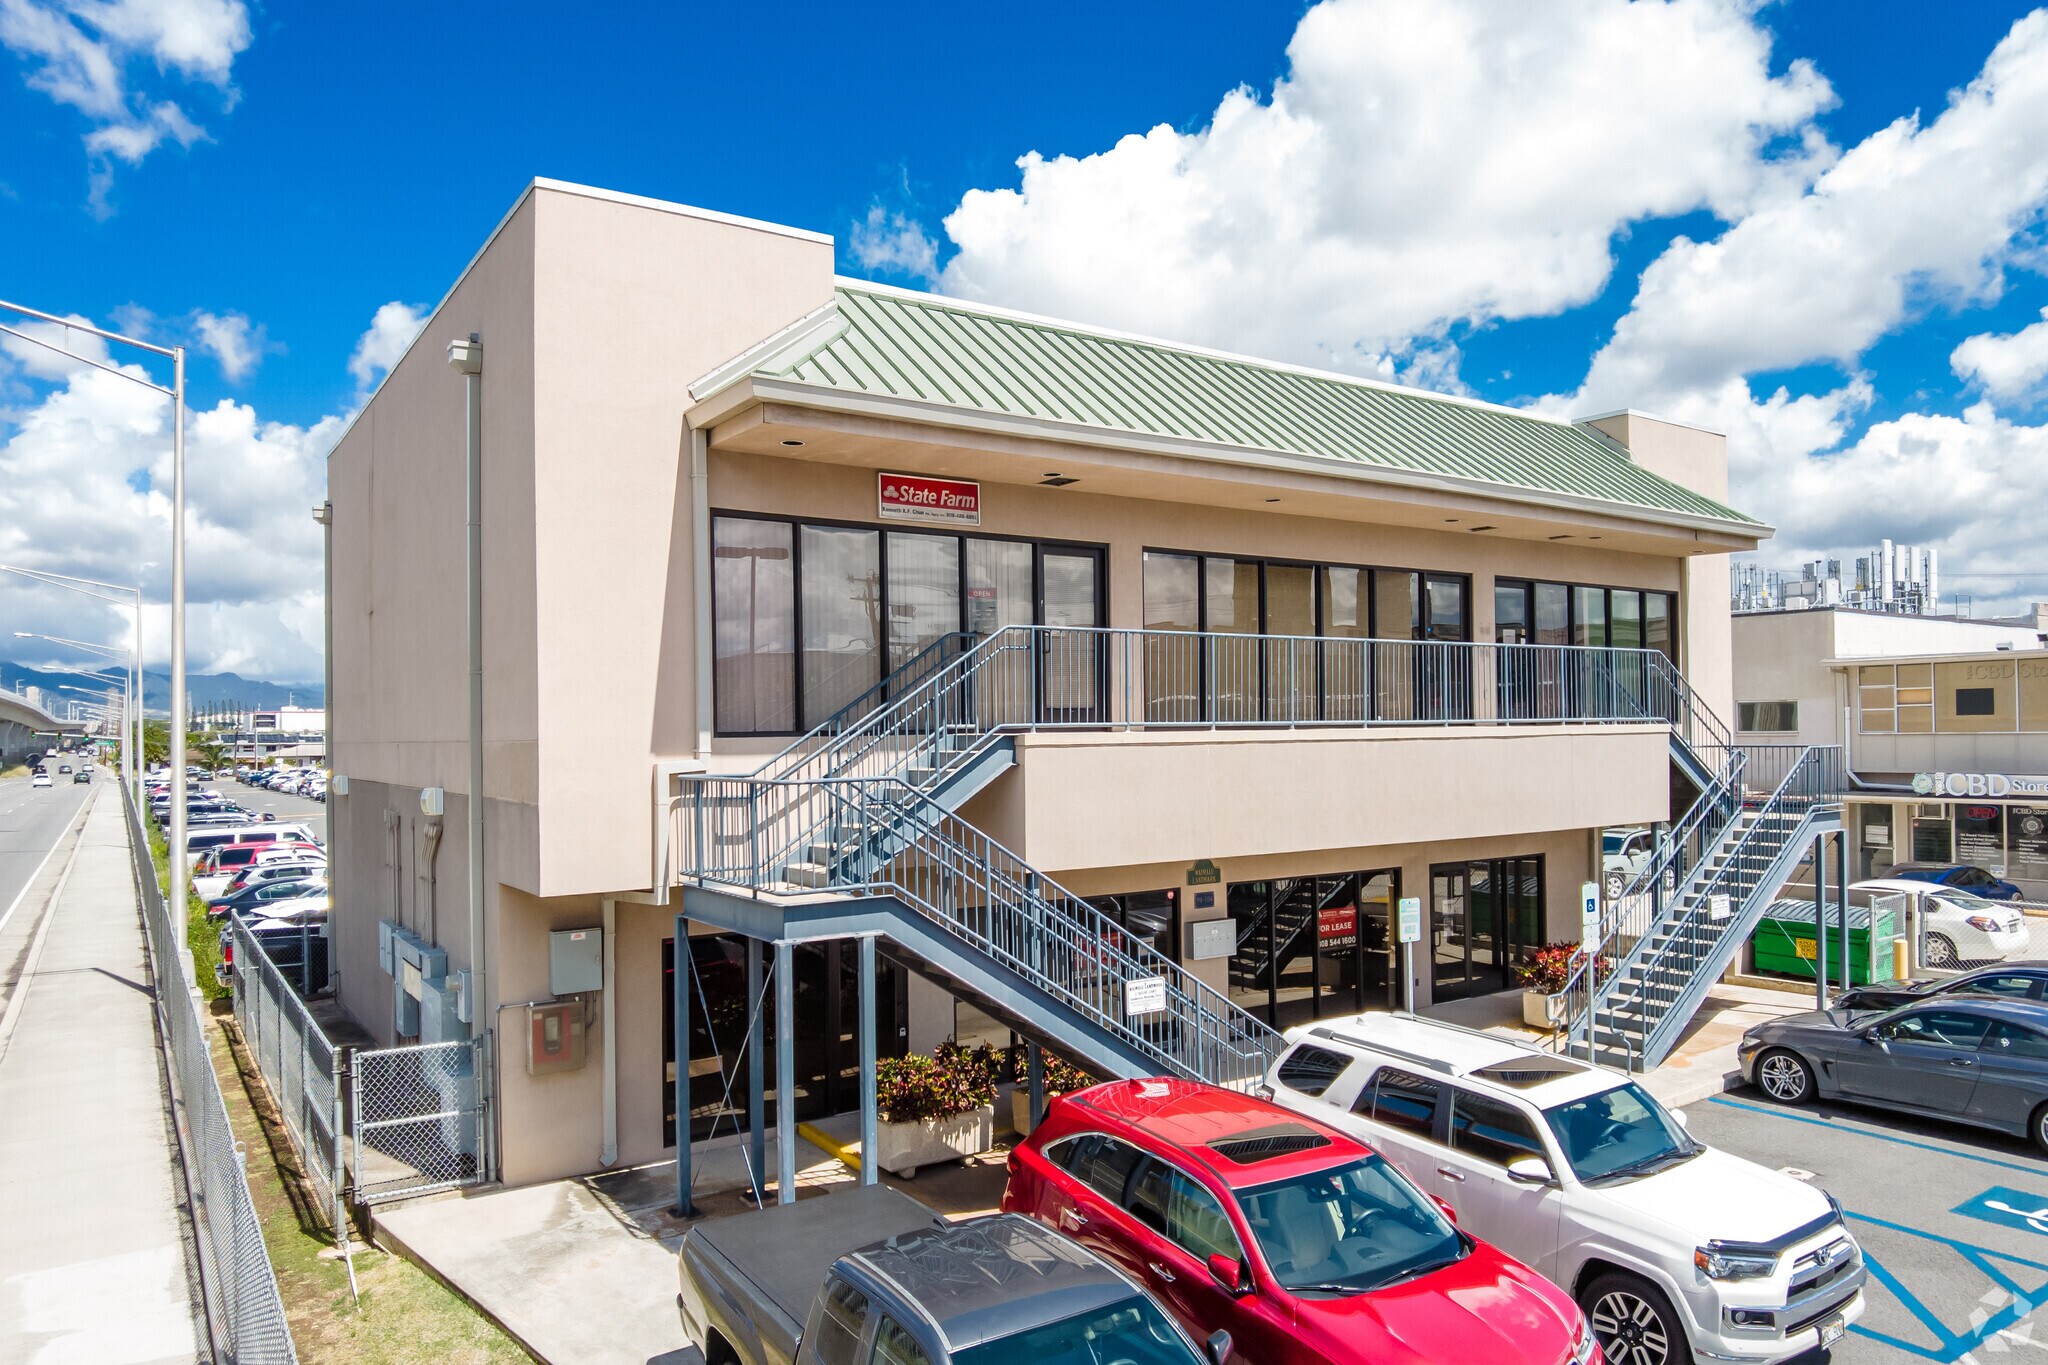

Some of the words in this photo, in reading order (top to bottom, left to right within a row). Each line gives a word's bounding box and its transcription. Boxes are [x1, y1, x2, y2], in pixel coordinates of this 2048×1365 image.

[899, 485, 937, 505] State
[940, 490, 975, 508] Farm
[1946, 773, 2010, 796] CBD
[1967, 806, 1997, 818] OPEN
[1319, 924, 1330, 932] OR
[1331, 922, 1352, 930] LEASE
[1329, 938, 1341, 946] 544
[1342, 936, 1356, 944] 1600
